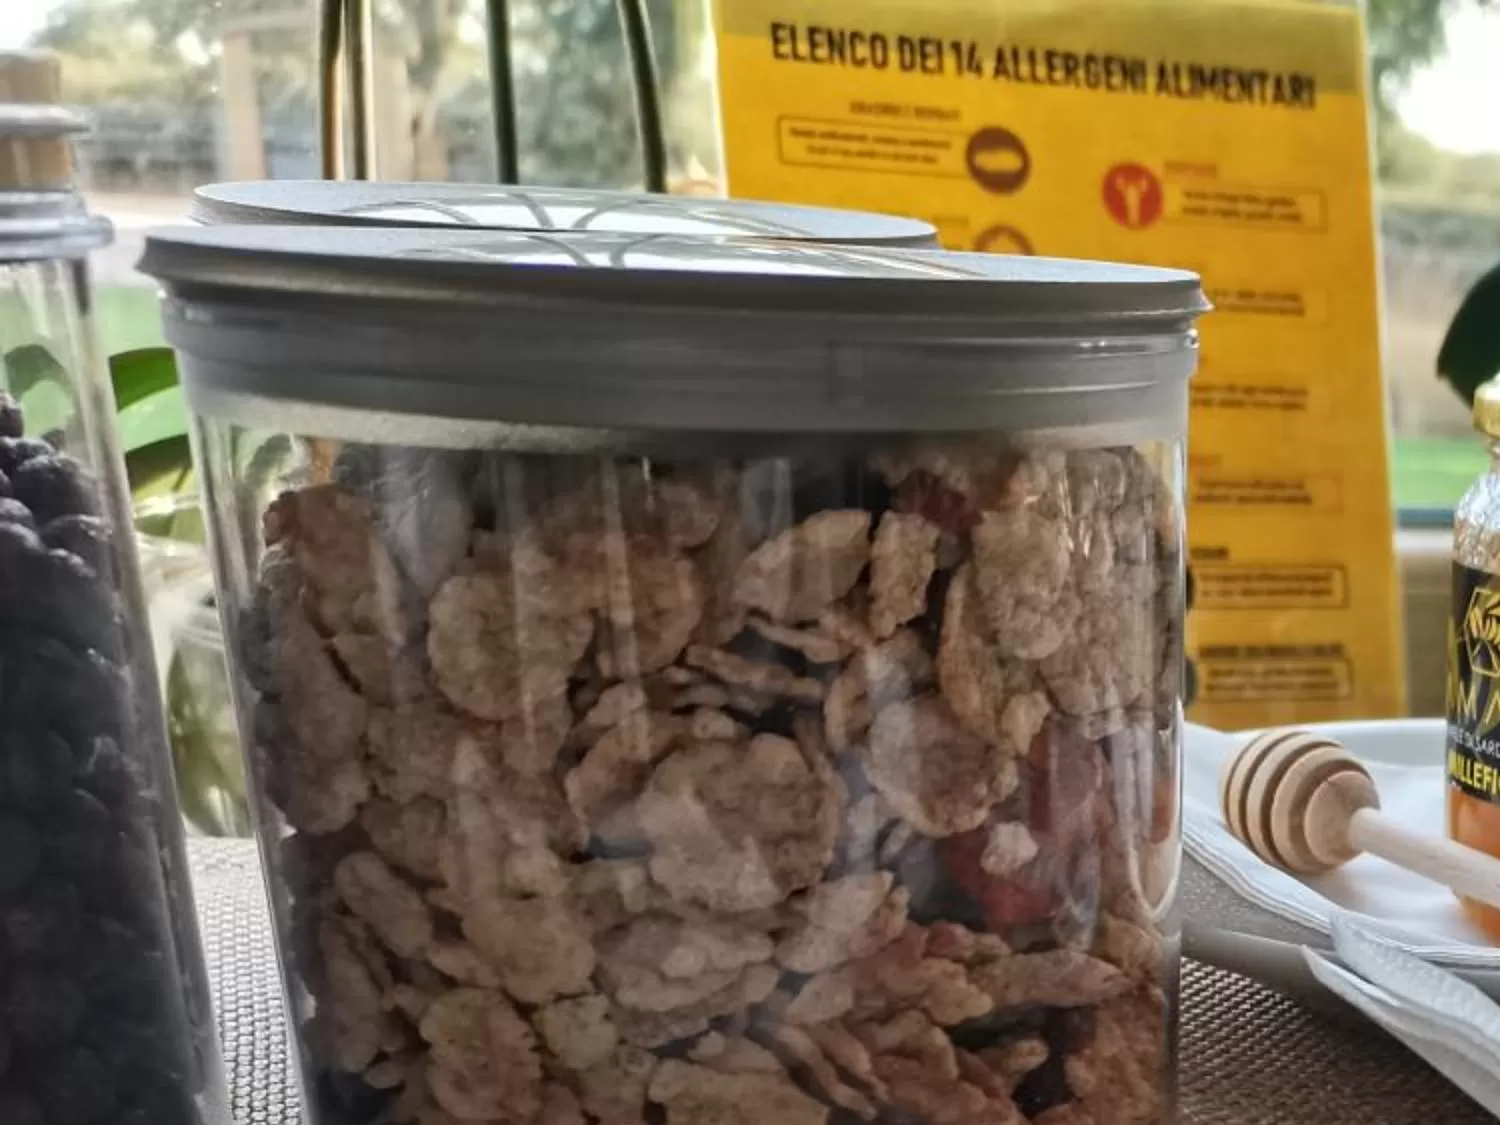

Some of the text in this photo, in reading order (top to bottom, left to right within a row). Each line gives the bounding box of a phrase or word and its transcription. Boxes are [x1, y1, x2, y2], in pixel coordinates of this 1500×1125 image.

[770, 22, 1316, 111] ELENCO DEI 14 ALLERGENI ALIMENTARI
